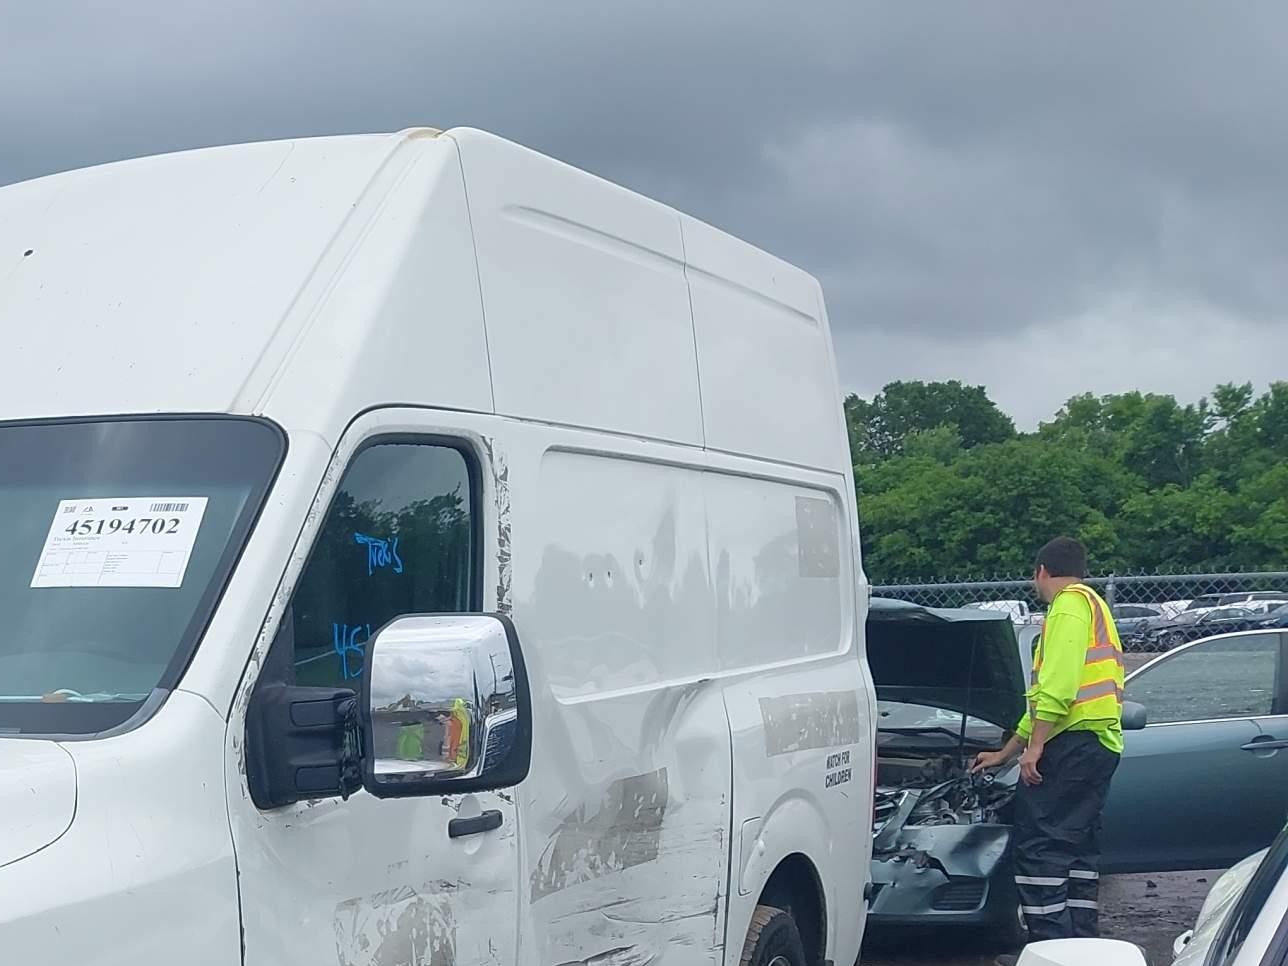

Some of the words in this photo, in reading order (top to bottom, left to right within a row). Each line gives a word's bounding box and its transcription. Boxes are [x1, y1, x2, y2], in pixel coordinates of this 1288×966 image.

[65, 518, 180, 536] 45194702
[333, 623, 371, 680] 45
[826, 753, 841, 770] WATCH
[841, 750, 850, 766] FOR
[825, 767, 852, 789] CHILDREN
